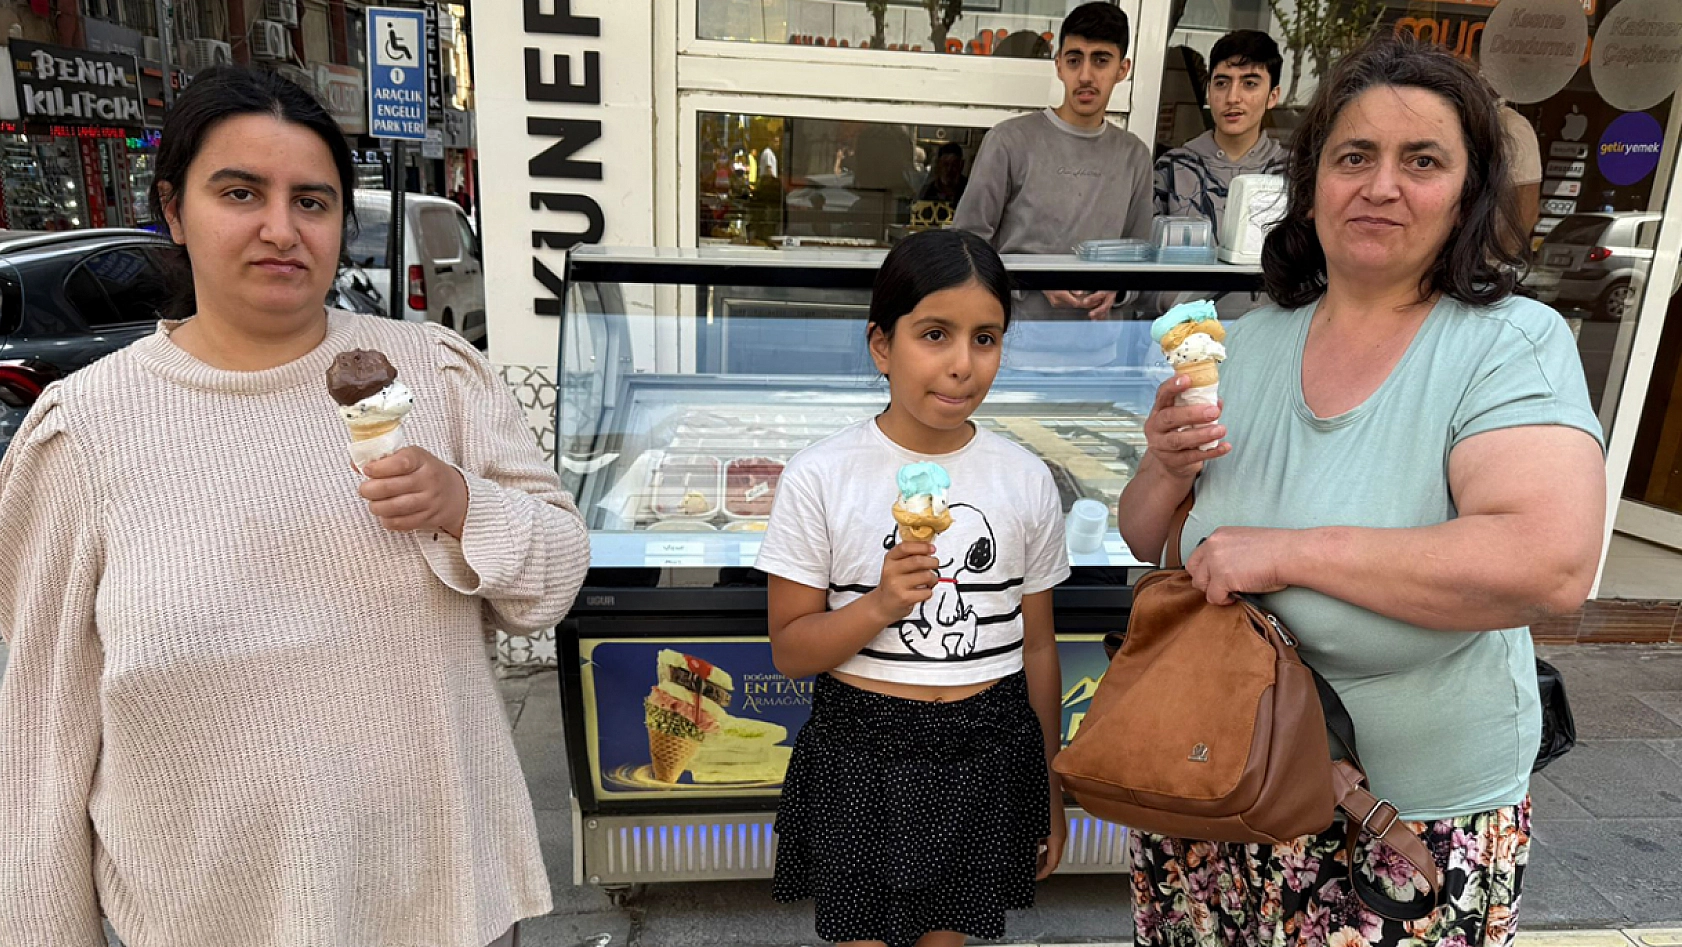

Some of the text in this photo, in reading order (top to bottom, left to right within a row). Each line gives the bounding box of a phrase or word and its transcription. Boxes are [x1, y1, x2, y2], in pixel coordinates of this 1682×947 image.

[1490, 34, 1577, 57] Dondurma
[374, 87, 423, 104] ARAÇLIK
[377, 103, 420, 119] ENGELLİ
[374, 119, 424, 134] PARK YERİ
[1600, 142, 1660, 156] getiryemek
[744, 681, 769, 694] EN
